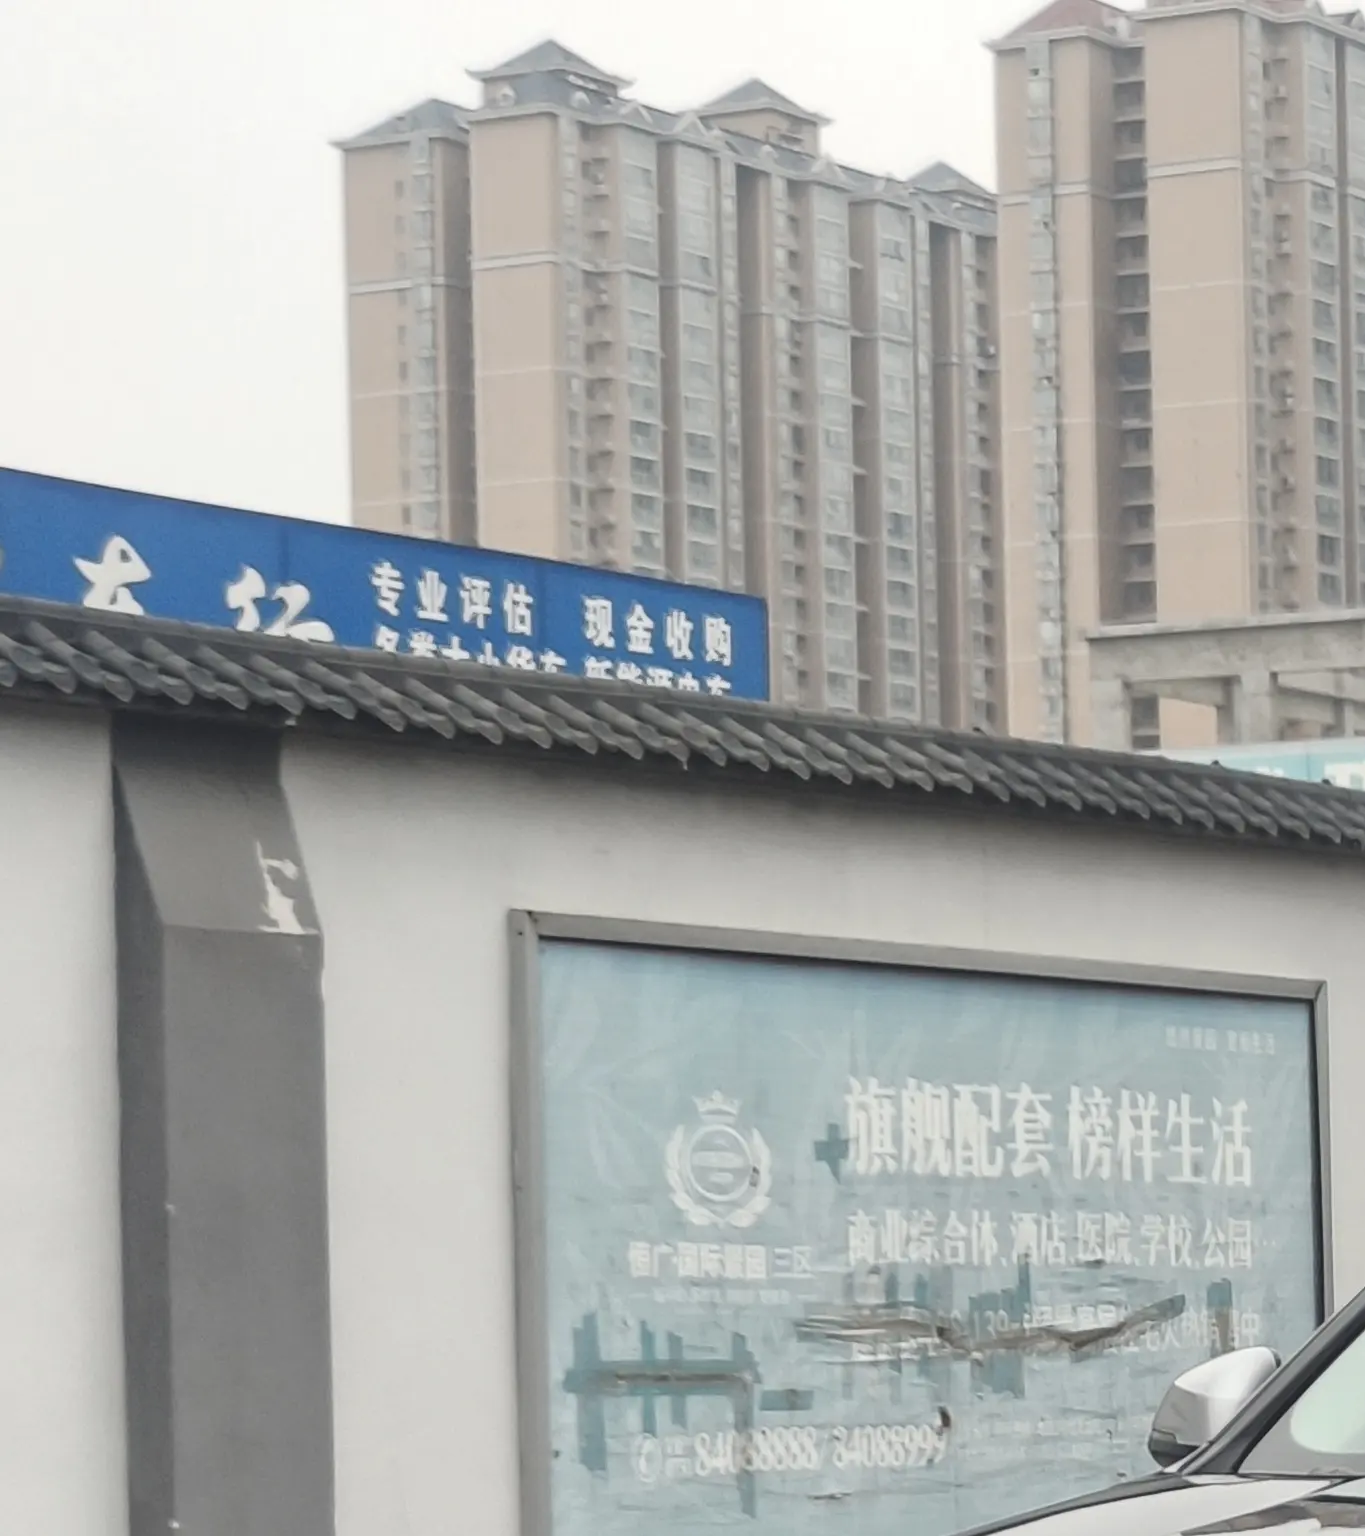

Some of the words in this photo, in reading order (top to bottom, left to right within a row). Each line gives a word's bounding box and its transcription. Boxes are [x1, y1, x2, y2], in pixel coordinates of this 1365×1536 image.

[368, 558, 536, 639] 专业评估
[581, 592, 735, 668] 现金收购
[844, 1074, 1054, 1180] 旗舰配套
[1065, 1084, 1253, 1188] 榜样生活
